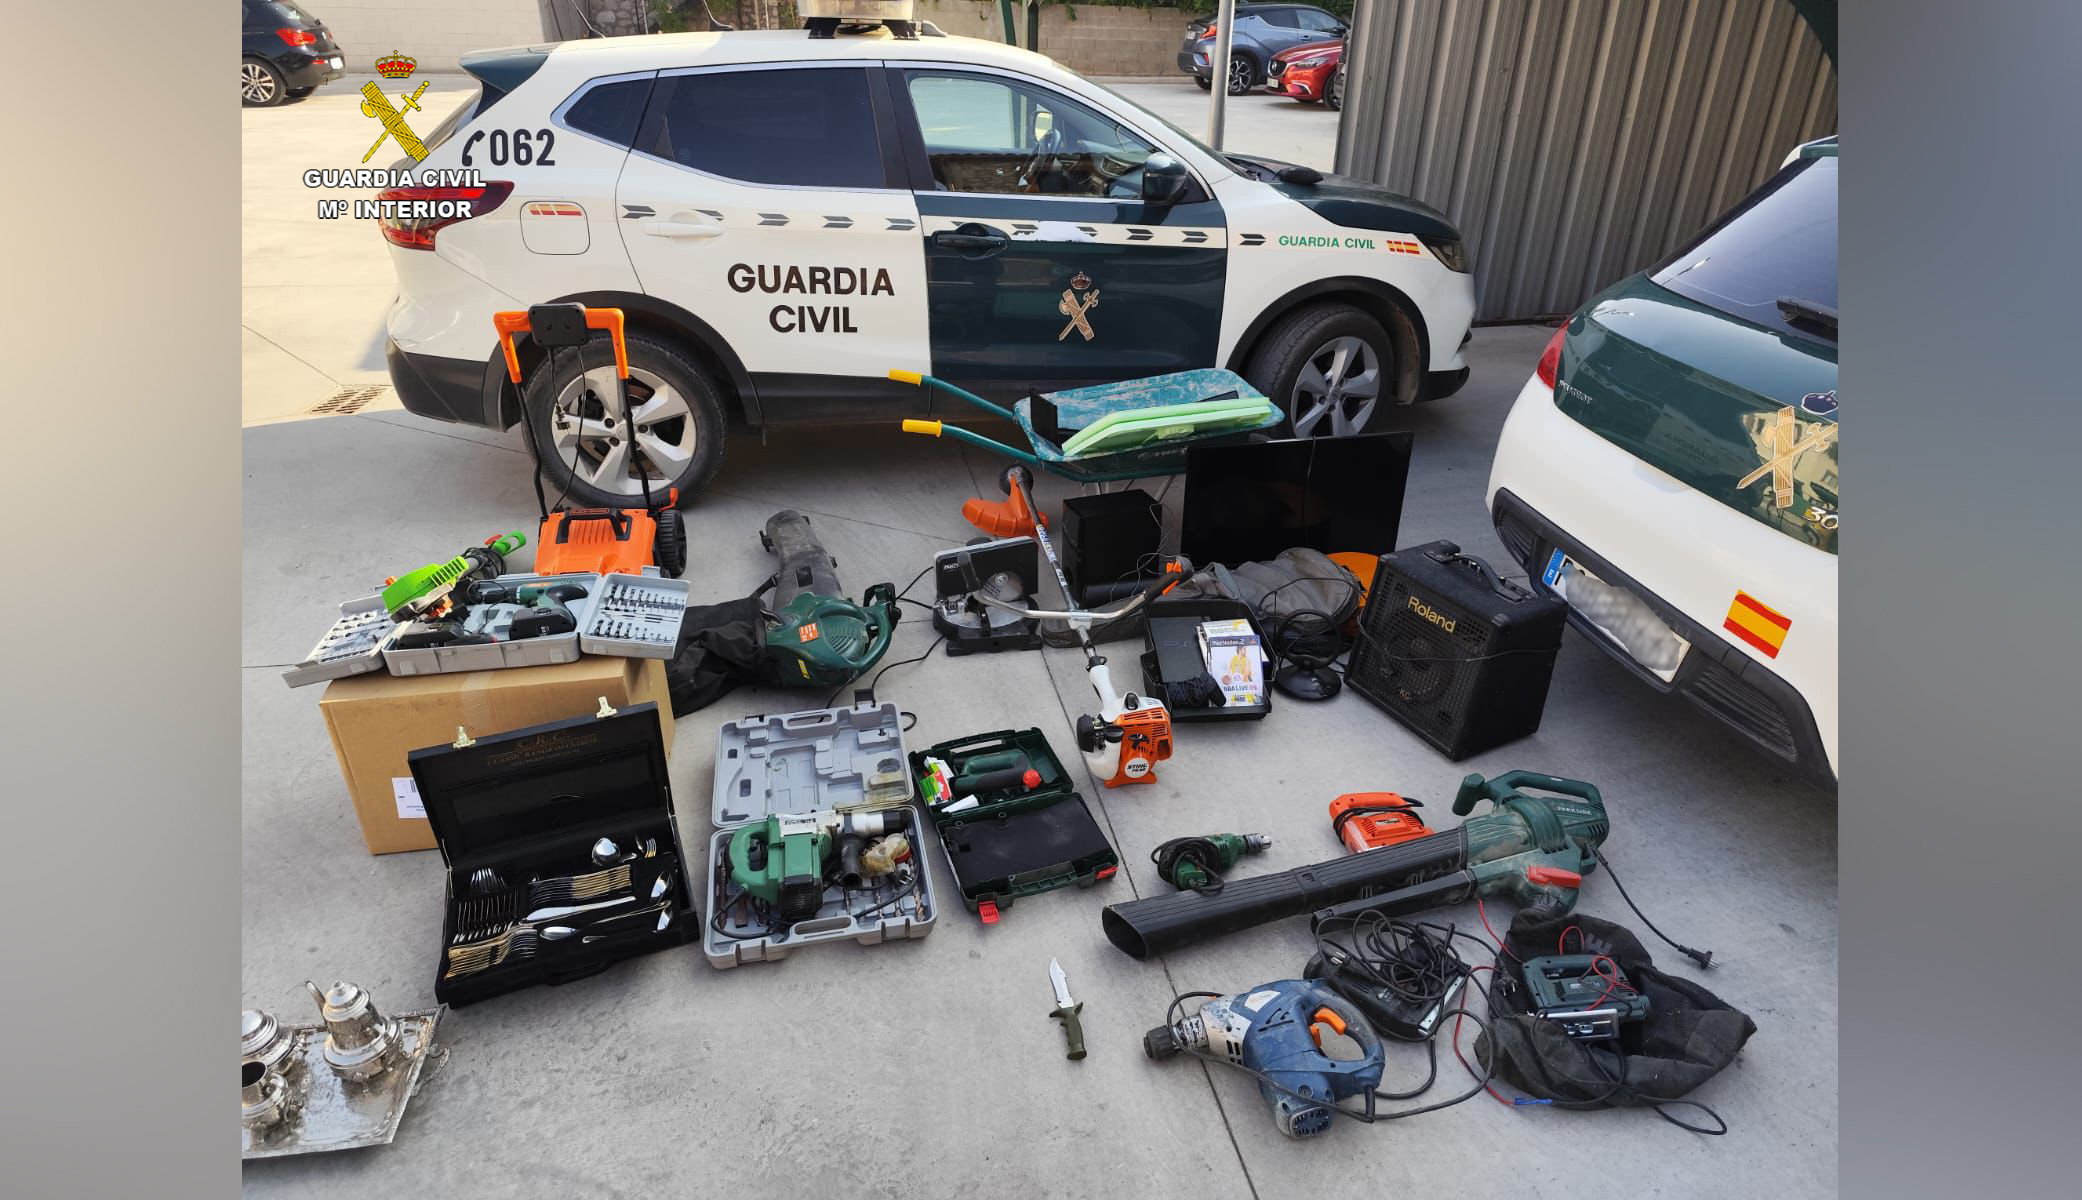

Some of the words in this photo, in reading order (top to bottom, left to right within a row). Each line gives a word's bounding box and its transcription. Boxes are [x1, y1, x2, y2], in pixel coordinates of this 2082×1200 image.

[490, 128, 555, 166] 062
[1278, 235, 1340, 248] GUARDIA
[1344, 238, 1376, 250] CIVIL
[727, 262, 895, 296] GUARDIA
[769, 304, 858, 333] CIVIL
[1407, 595, 1456, 633] Roland
